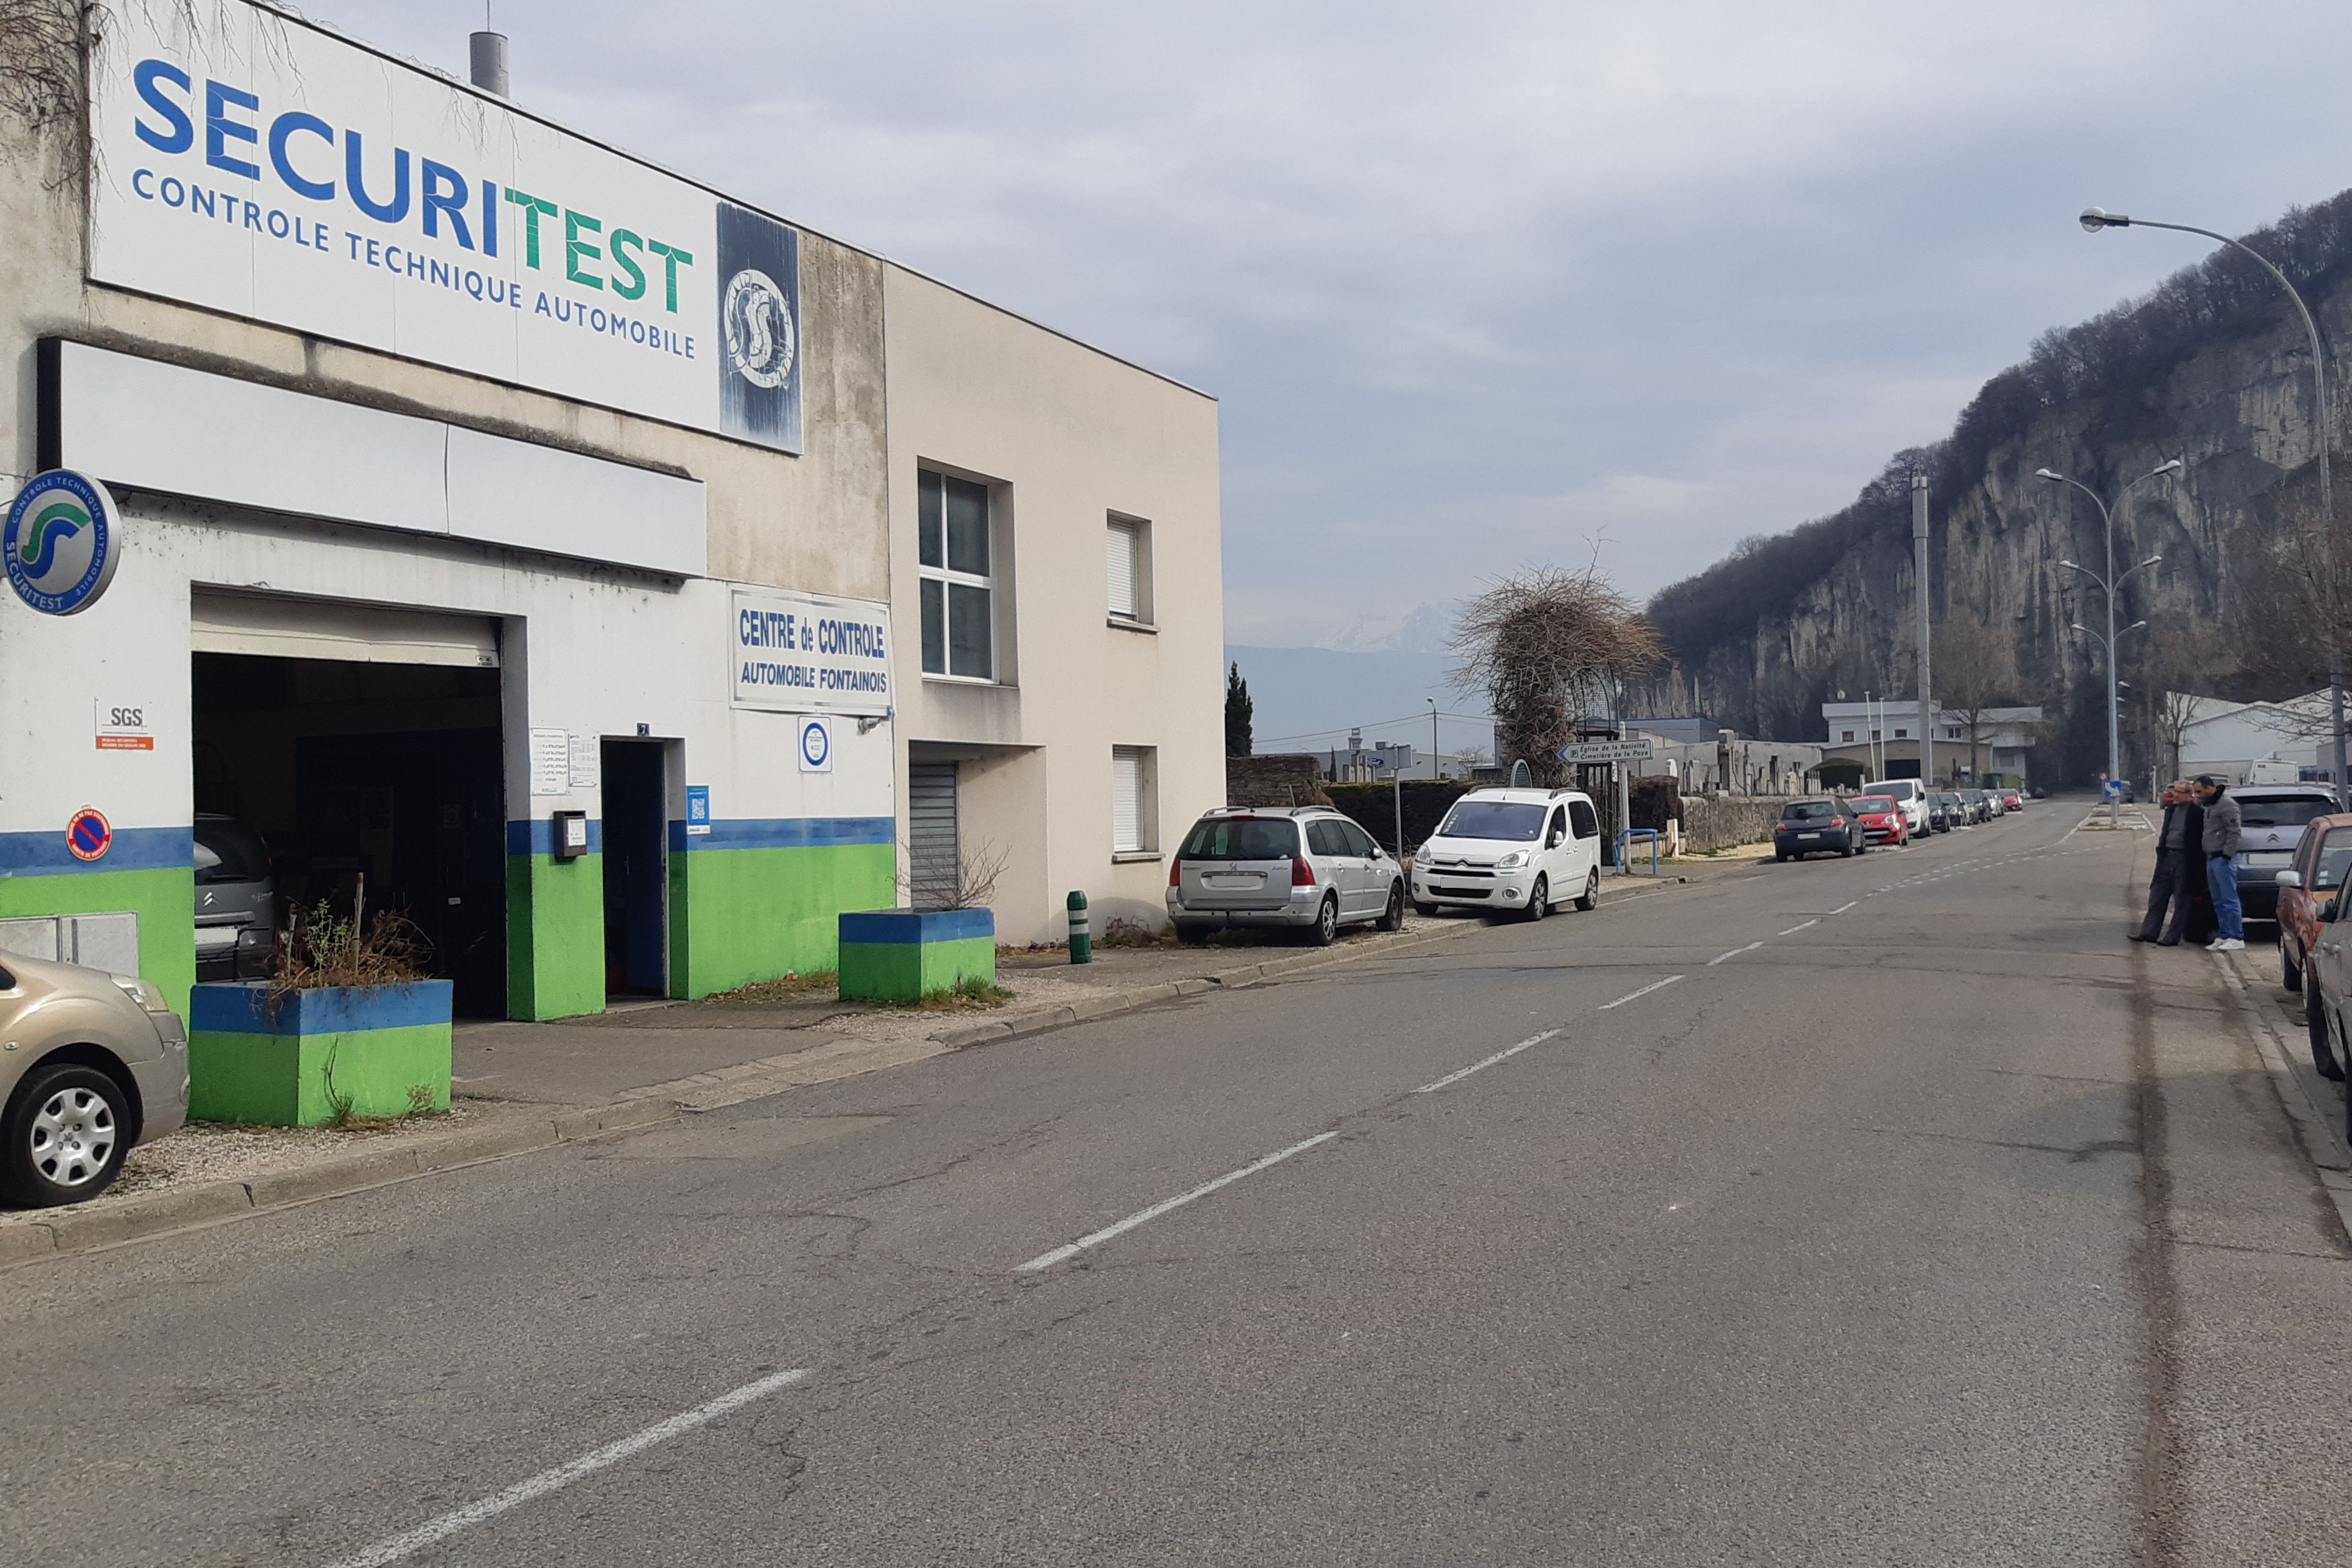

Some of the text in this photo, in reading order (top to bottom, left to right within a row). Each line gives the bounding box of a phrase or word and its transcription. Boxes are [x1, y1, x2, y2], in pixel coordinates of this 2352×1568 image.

[133, 59, 693, 313] SECURITEST
[132, 168, 695, 359] CONTROLE TECHNIQUE AUTOMOBILE
[11, 477, 105, 596] CONTROLE TECHNIQUE AUTOMOBILE
[7, 542, 63, 609] SECURITEST
[740, 609, 885, 658] CENTRE de CONTROLE
[741, 661, 886, 693] AUTOMOBILE FONTAINOIS
[111, 707, 142, 727] SGS
[641, 725, 646, 734] 7
[1580, 745, 1599, 753] Église
